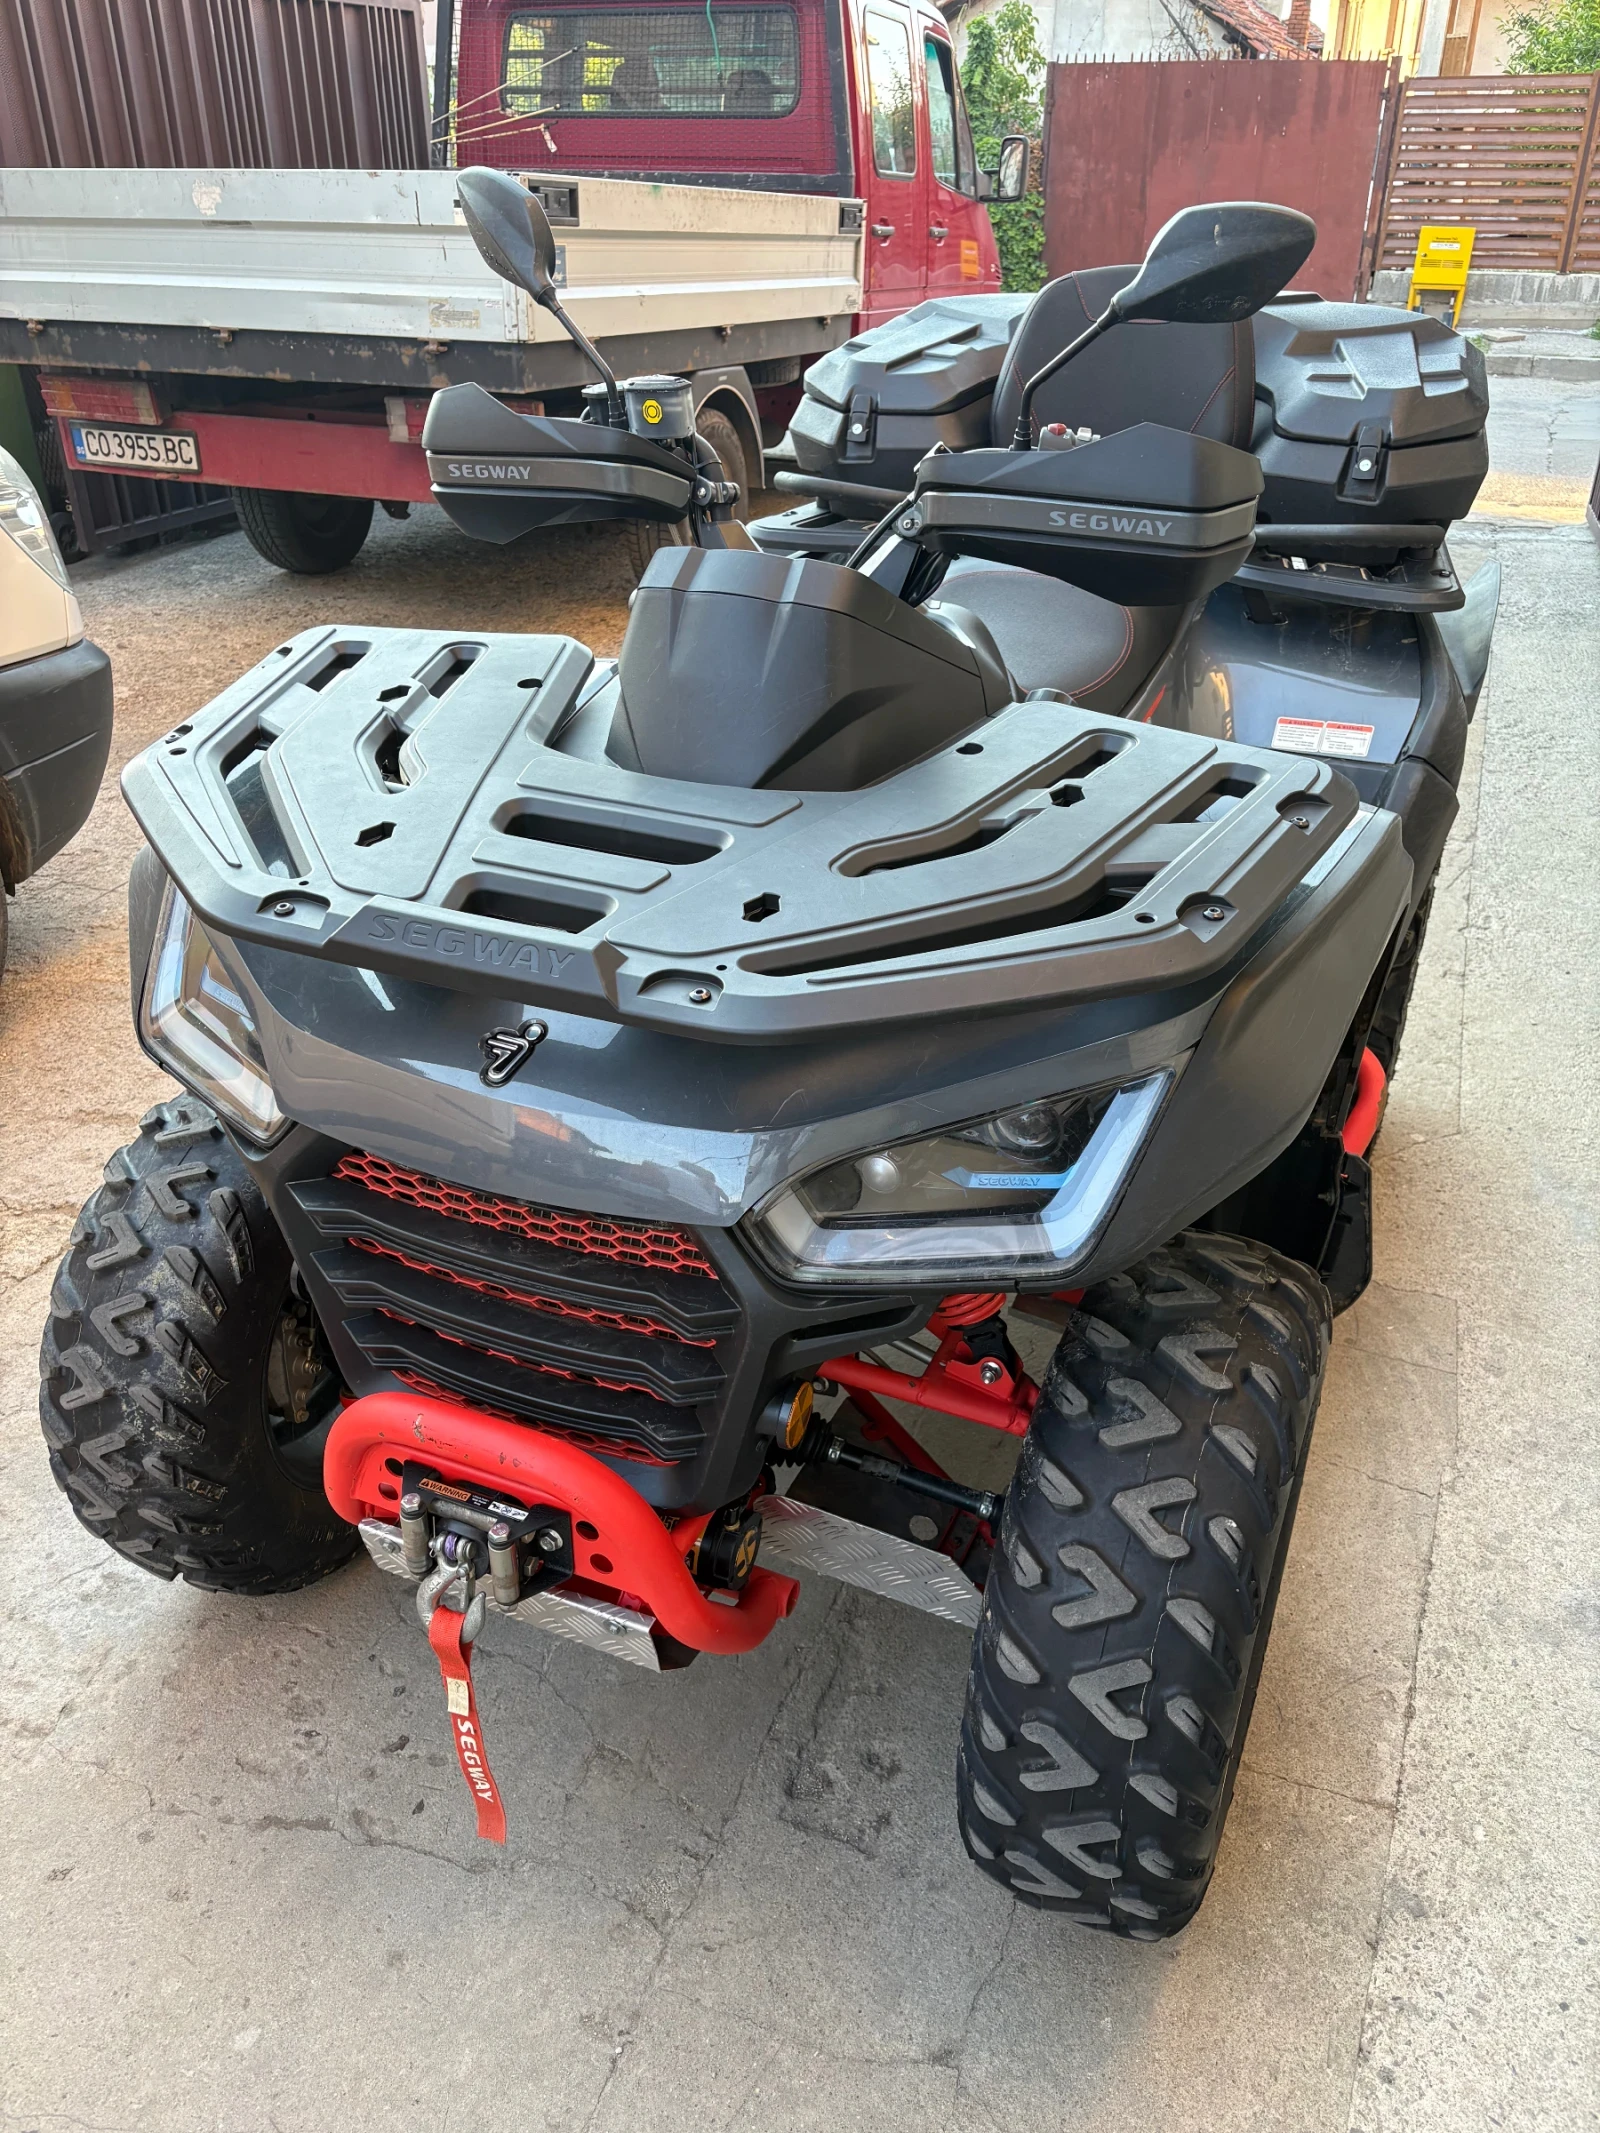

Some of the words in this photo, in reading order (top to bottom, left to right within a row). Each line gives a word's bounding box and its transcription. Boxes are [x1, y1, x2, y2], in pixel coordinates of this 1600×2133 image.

[448, 464, 531, 480] SEGWAY
[1048, 511, 1172, 537] SEGWAY
[368, 914, 575, 977] SEGWAY
[978, 1176, 1041, 1187] SEGWAY
[429, 1482, 469, 1501] WARNING
[457, 1718, 494, 1803] SEGWAY
